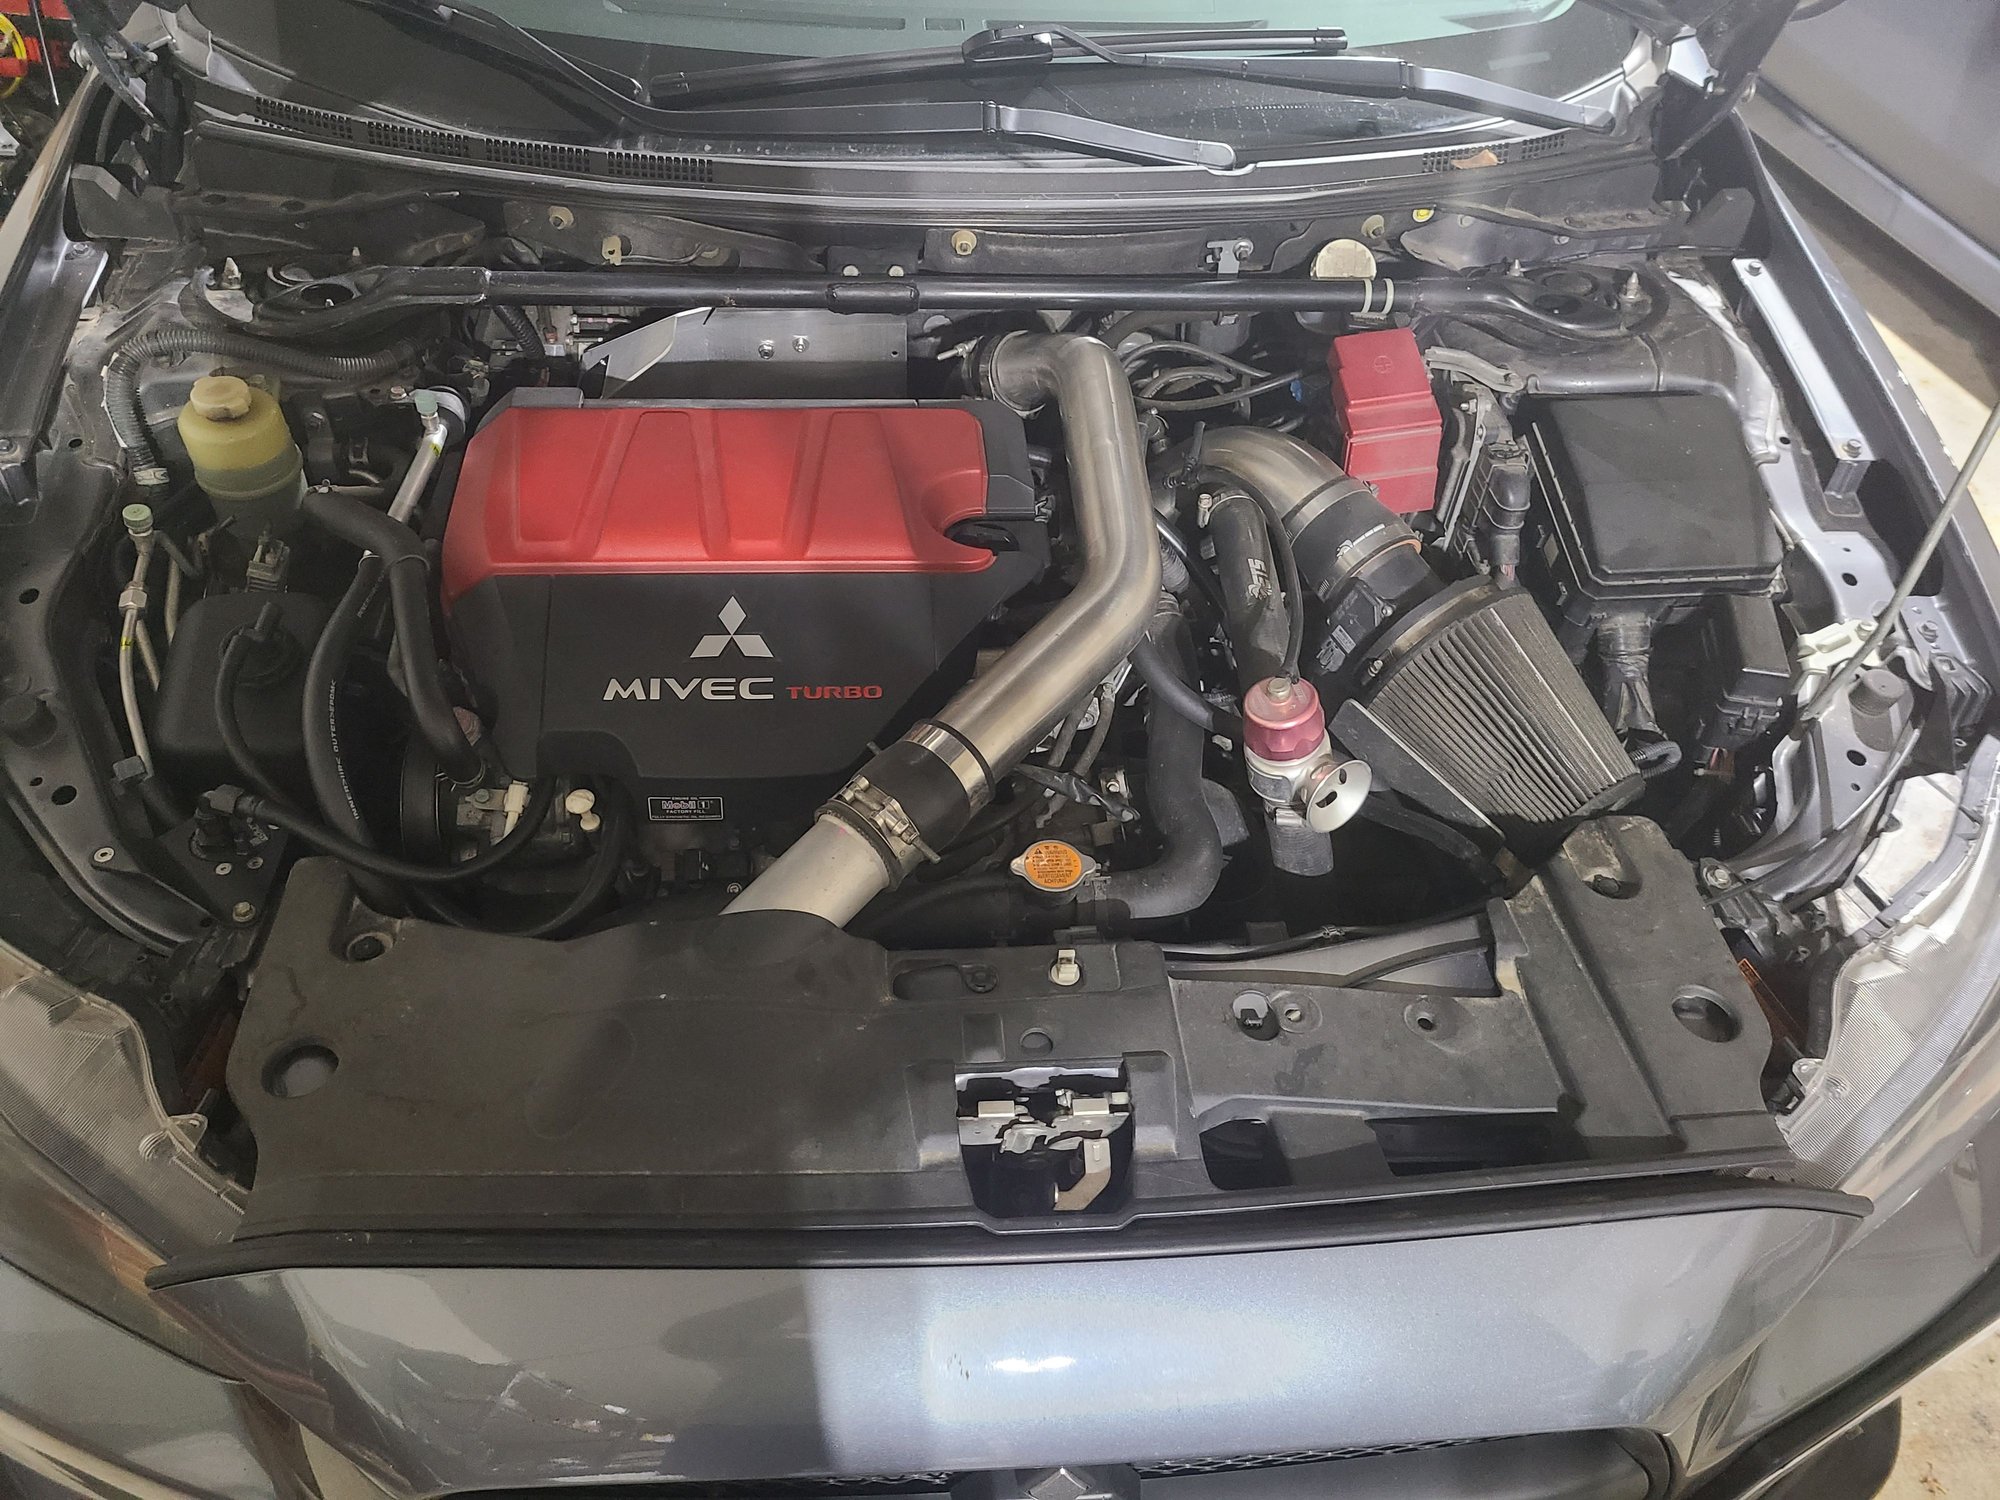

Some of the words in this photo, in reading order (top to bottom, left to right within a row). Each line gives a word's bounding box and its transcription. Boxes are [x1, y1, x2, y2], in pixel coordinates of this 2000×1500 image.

[603, 677, 774, 701] MIVEC
[786, 685, 883, 700] TURBO
[661, 800, 696, 809] Mobil
